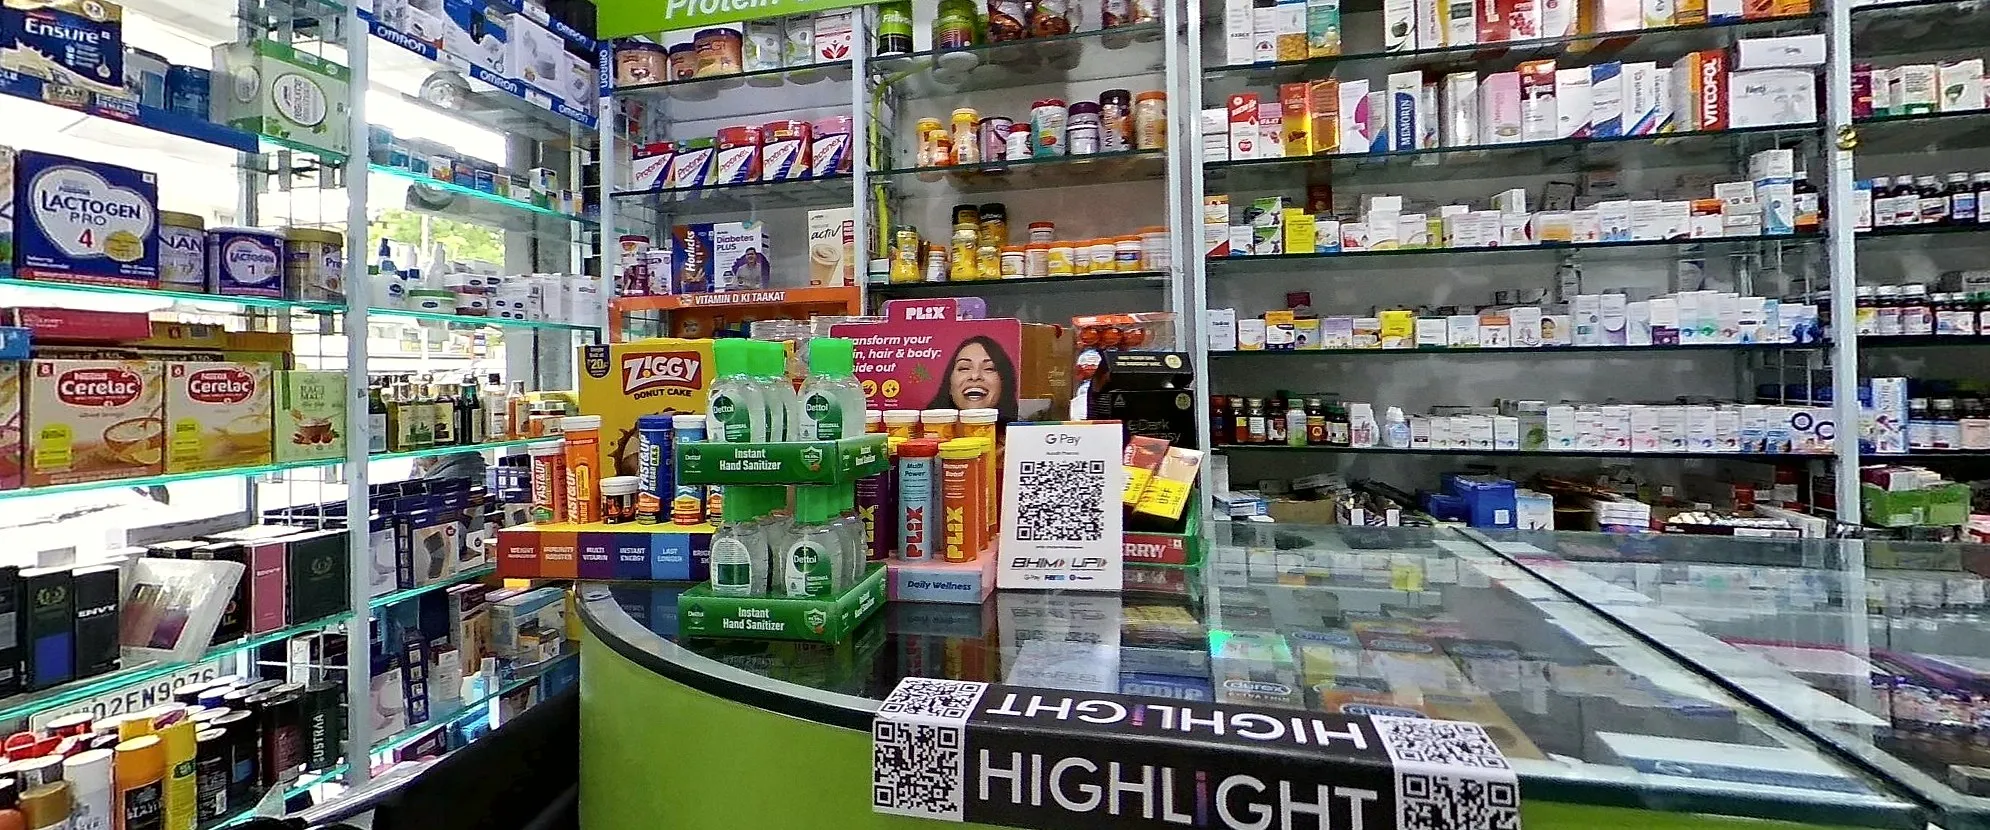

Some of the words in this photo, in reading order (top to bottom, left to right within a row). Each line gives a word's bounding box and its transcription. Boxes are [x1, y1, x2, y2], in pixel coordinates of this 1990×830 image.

[25, 18, 98, 44] Ensure
[376, 26, 427, 55] OMRON
[41, 190, 141, 219] LACTOGEN
[70, 212, 106, 226] PRO
[79, 229, 93, 248] 4
[811, 225, 842, 240] activ
[717, 235, 754, 244] Diabetes
[717, 243, 736, 251] PLUS
[695, 294, 731, 305] VITAMIN
[741, 293, 750, 303] KI
[752, 291, 786, 302] TAAKAT
[903, 336, 932, 346] your
[868, 349, 893, 359] hair
[895, 348, 905, 358] &
[907, 347, 942, 359] body:
[875, 363, 896, 373] out
[60, 379, 137, 395] Cerelac
[190, 380, 250, 393] Cerelac
[633, 388, 665, 400] DONUT
[667, 388, 692, 397] CAKE
[712, 404, 735, 415] Dettol
[805, 403, 829, 413] Dettol
[1045, 433, 1057, 444] G
[1060, 434, 1081, 446] Pay
[734, 449, 766, 459] Instant
[719, 460, 741, 471] Hand
[742, 460, 782, 471] Sanitizer
[793, 555, 818, 565] Dettol
[1011, 557, 1058, 569] BHIM
[907, 580, 931, 589] Daily
[932, 581, 972, 591] Wellness
[77, 603, 117, 618] ENVY
[739, 607, 770, 618] Instant
[723, 619, 745, 630] Hand
[746, 620, 785, 631] Sanitizer
